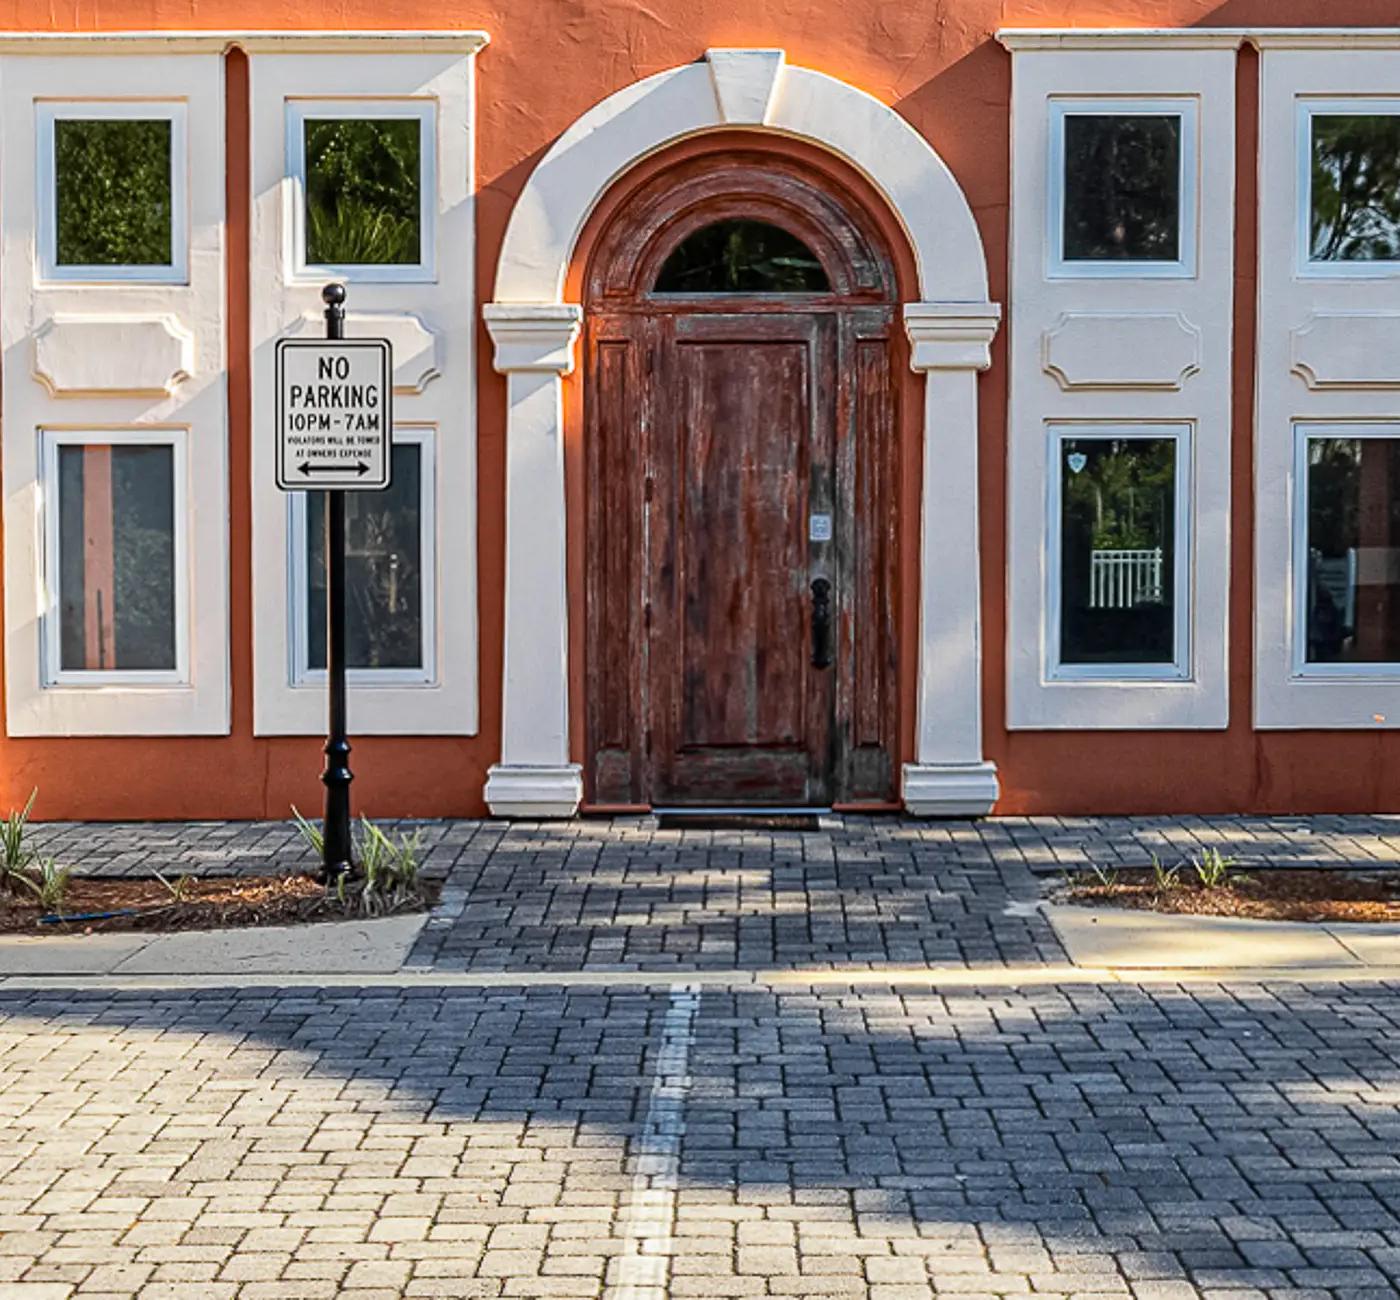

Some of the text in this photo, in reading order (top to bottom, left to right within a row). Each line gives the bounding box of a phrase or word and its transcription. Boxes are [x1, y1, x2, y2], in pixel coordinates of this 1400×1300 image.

[319, 356, 350, 380] NO
[290, 385, 378, 408] PARKING
[287, 435, 379, 445] VIOLATORS WILL BE TOWED
[295, 448, 304, 459] AT
[339, 448, 372, 459] EXPENSE
